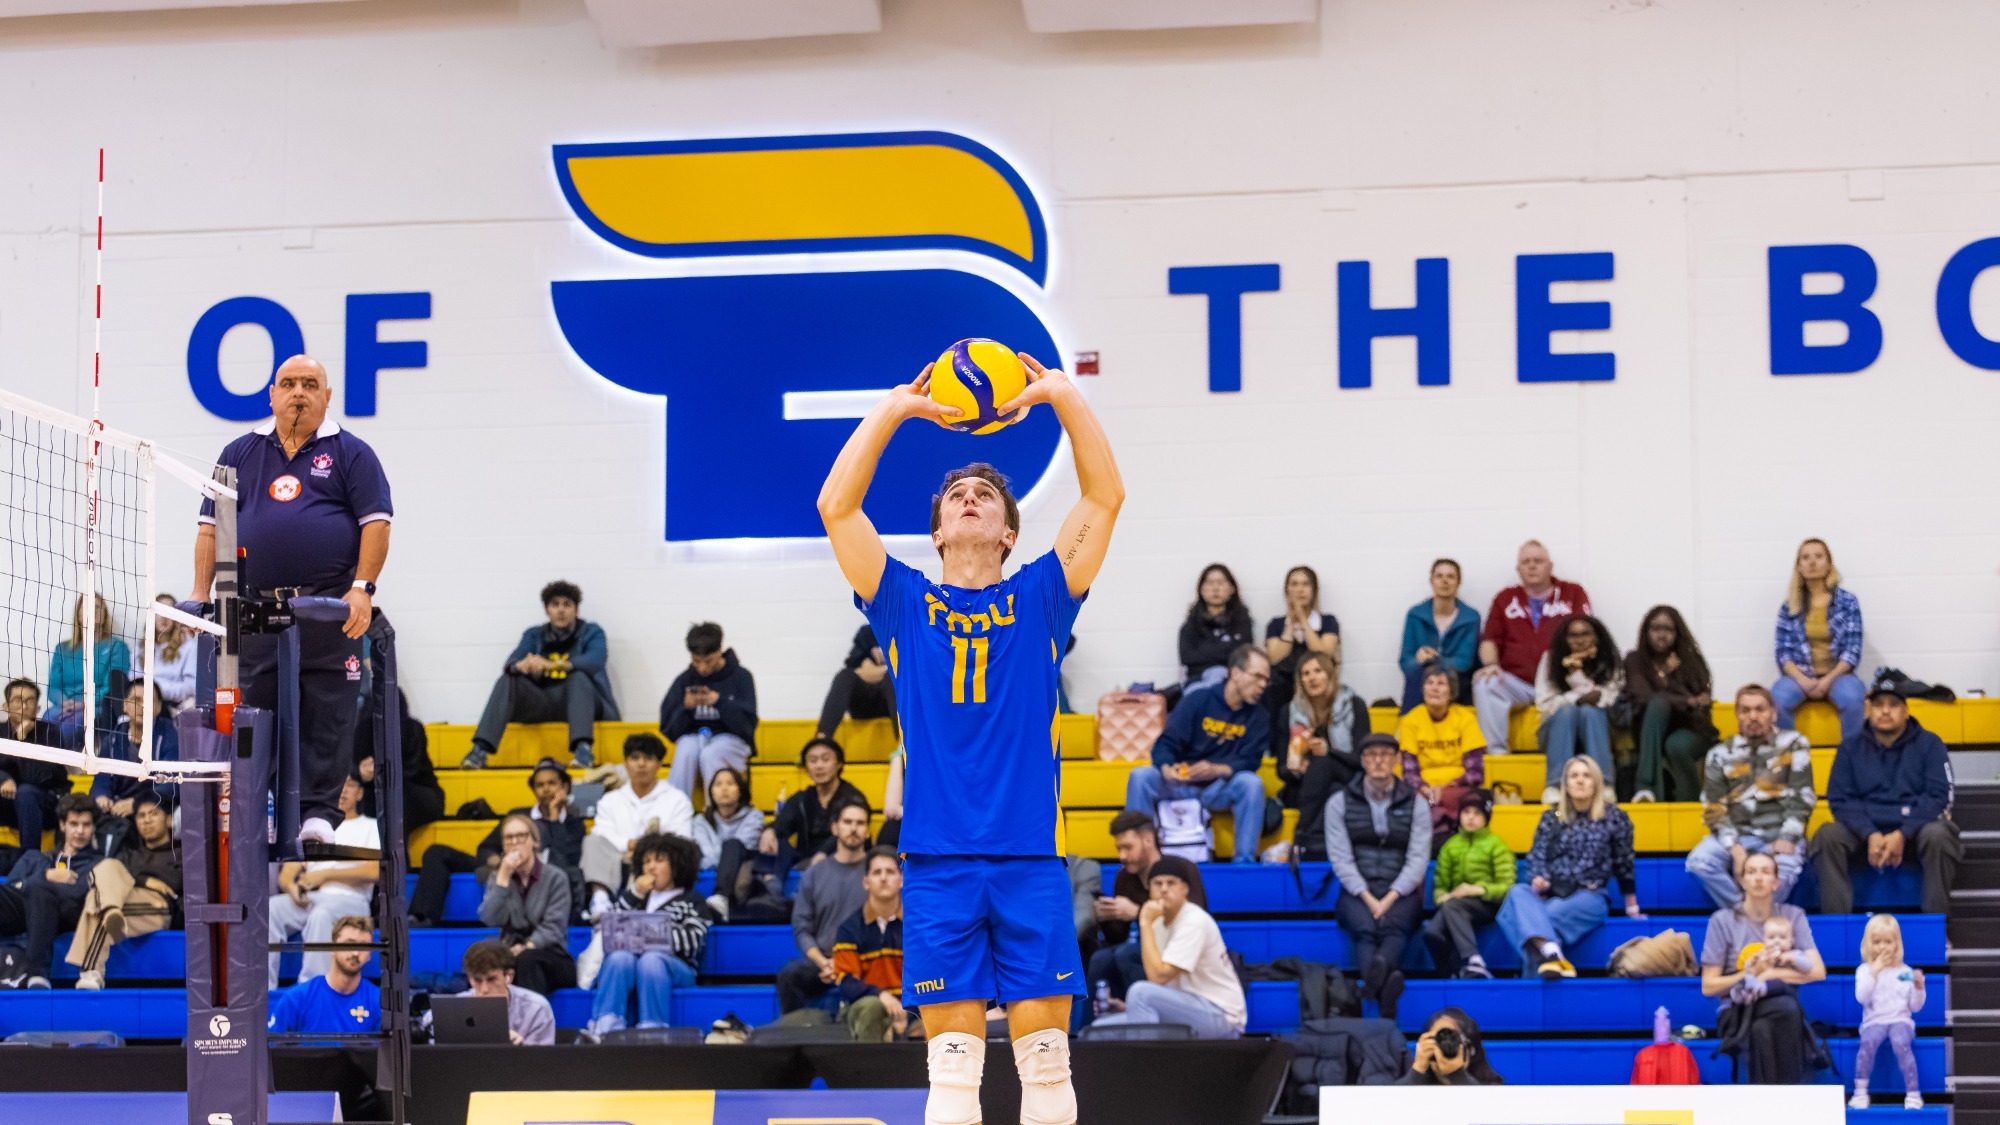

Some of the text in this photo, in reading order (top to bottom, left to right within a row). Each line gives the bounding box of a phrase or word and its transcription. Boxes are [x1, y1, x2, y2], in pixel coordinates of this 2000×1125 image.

[187, 291, 432, 423] OF
[1168, 251, 1616, 393] THE
[961, 365, 983, 387] V200W
[1075, 523, 1091, 543] LXVI
[924, 592, 1016, 633] TMU
[951, 634, 989, 703] 11
[914, 977, 945, 995] TMU
[194, 1039, 218, 1049] SPORTS
